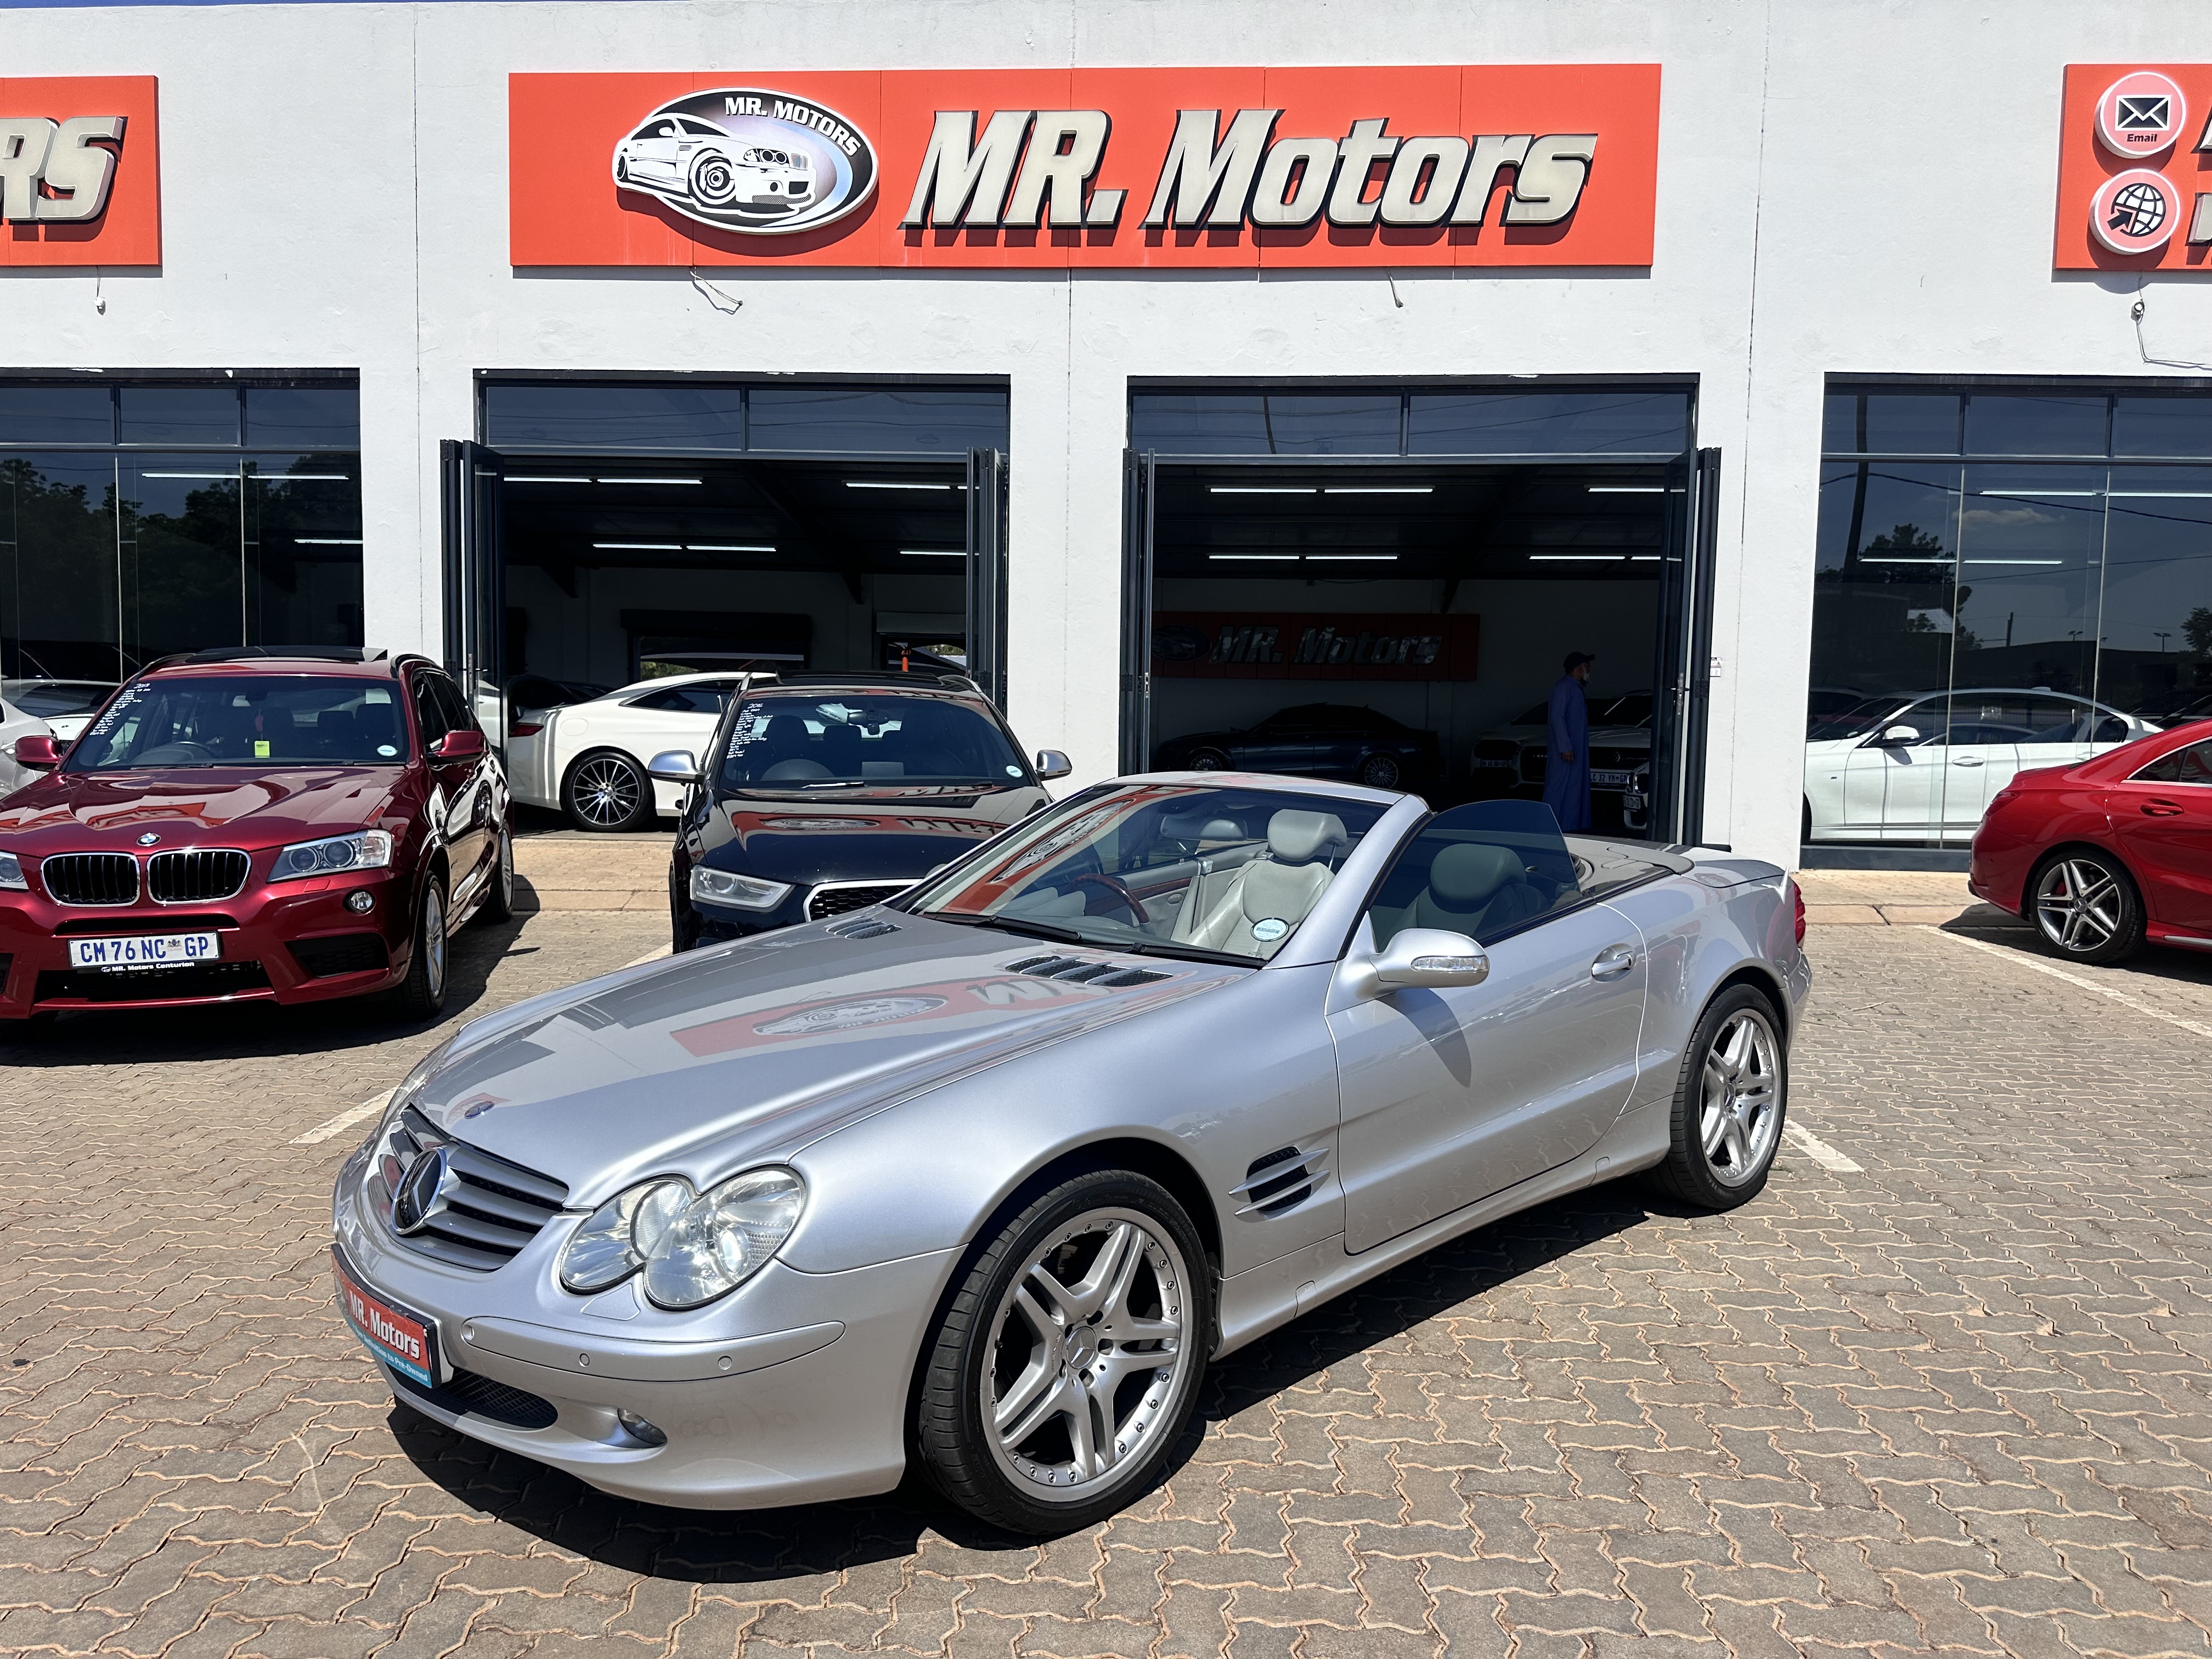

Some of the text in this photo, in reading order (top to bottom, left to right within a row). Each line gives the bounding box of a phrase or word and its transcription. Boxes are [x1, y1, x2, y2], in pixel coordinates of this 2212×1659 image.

[725, 97, 861, 156] MR. MOTORS
[2126, 133, 2158, 143] Email
[902, 109, 1598, 225] MR. Motors
[1209, 625, 1443, 665] MR. Motors
[80, 936, 209, 962] CM 76 NC GP
[156, 961, 195, 969] Centurion
[349, 1289, 420, 1359] MR. Motors
[387, 1353, 394, 1362] to
[394, 1357, 428, 1382] Pre-Owned
